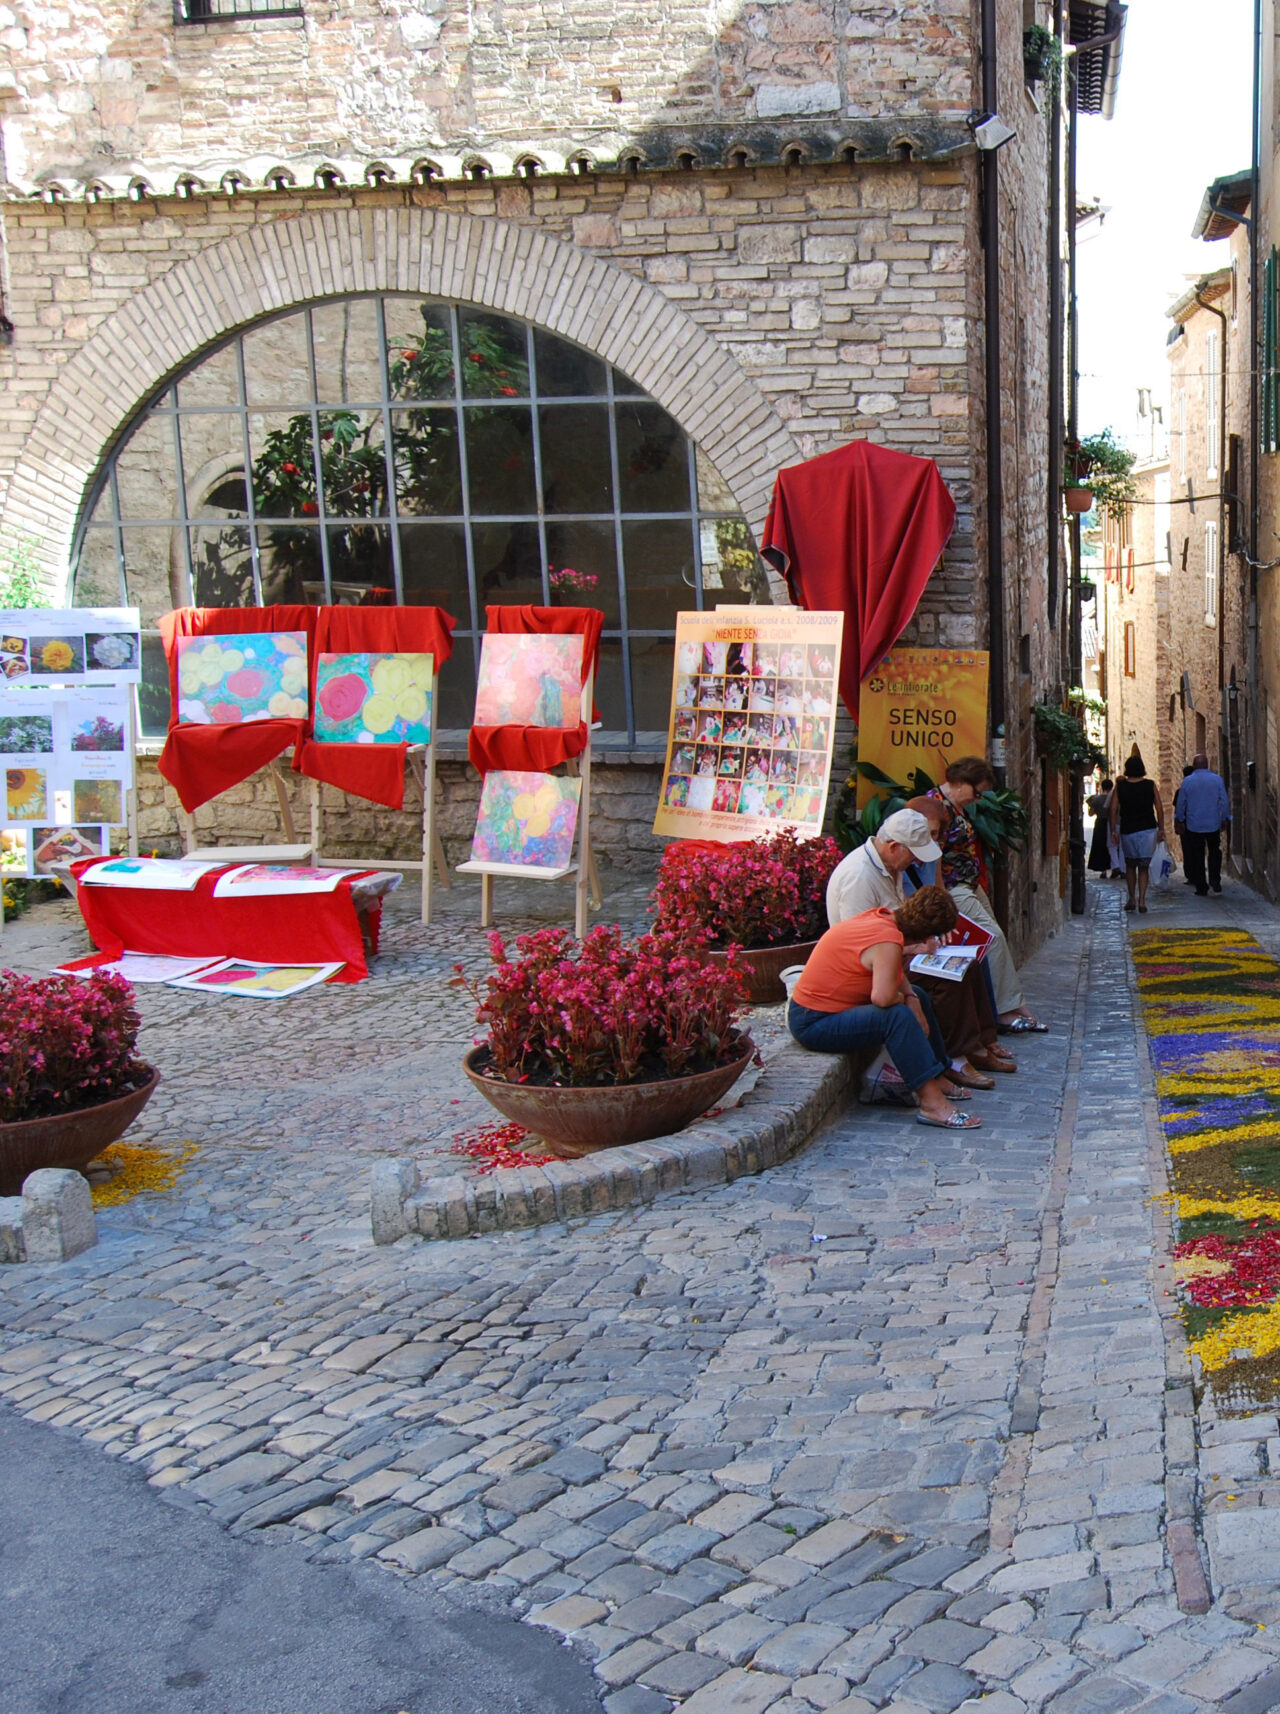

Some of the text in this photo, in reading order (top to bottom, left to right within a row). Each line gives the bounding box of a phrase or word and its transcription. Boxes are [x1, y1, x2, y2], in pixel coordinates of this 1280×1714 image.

[796, 615, 838, 625] 2008/2009
[743, 627, 768, 640] SENZA
[887, 679, 897, 692] Le
[889, 708, 957, 726] SENSO
[891, 730, 954, 748] UNICO
